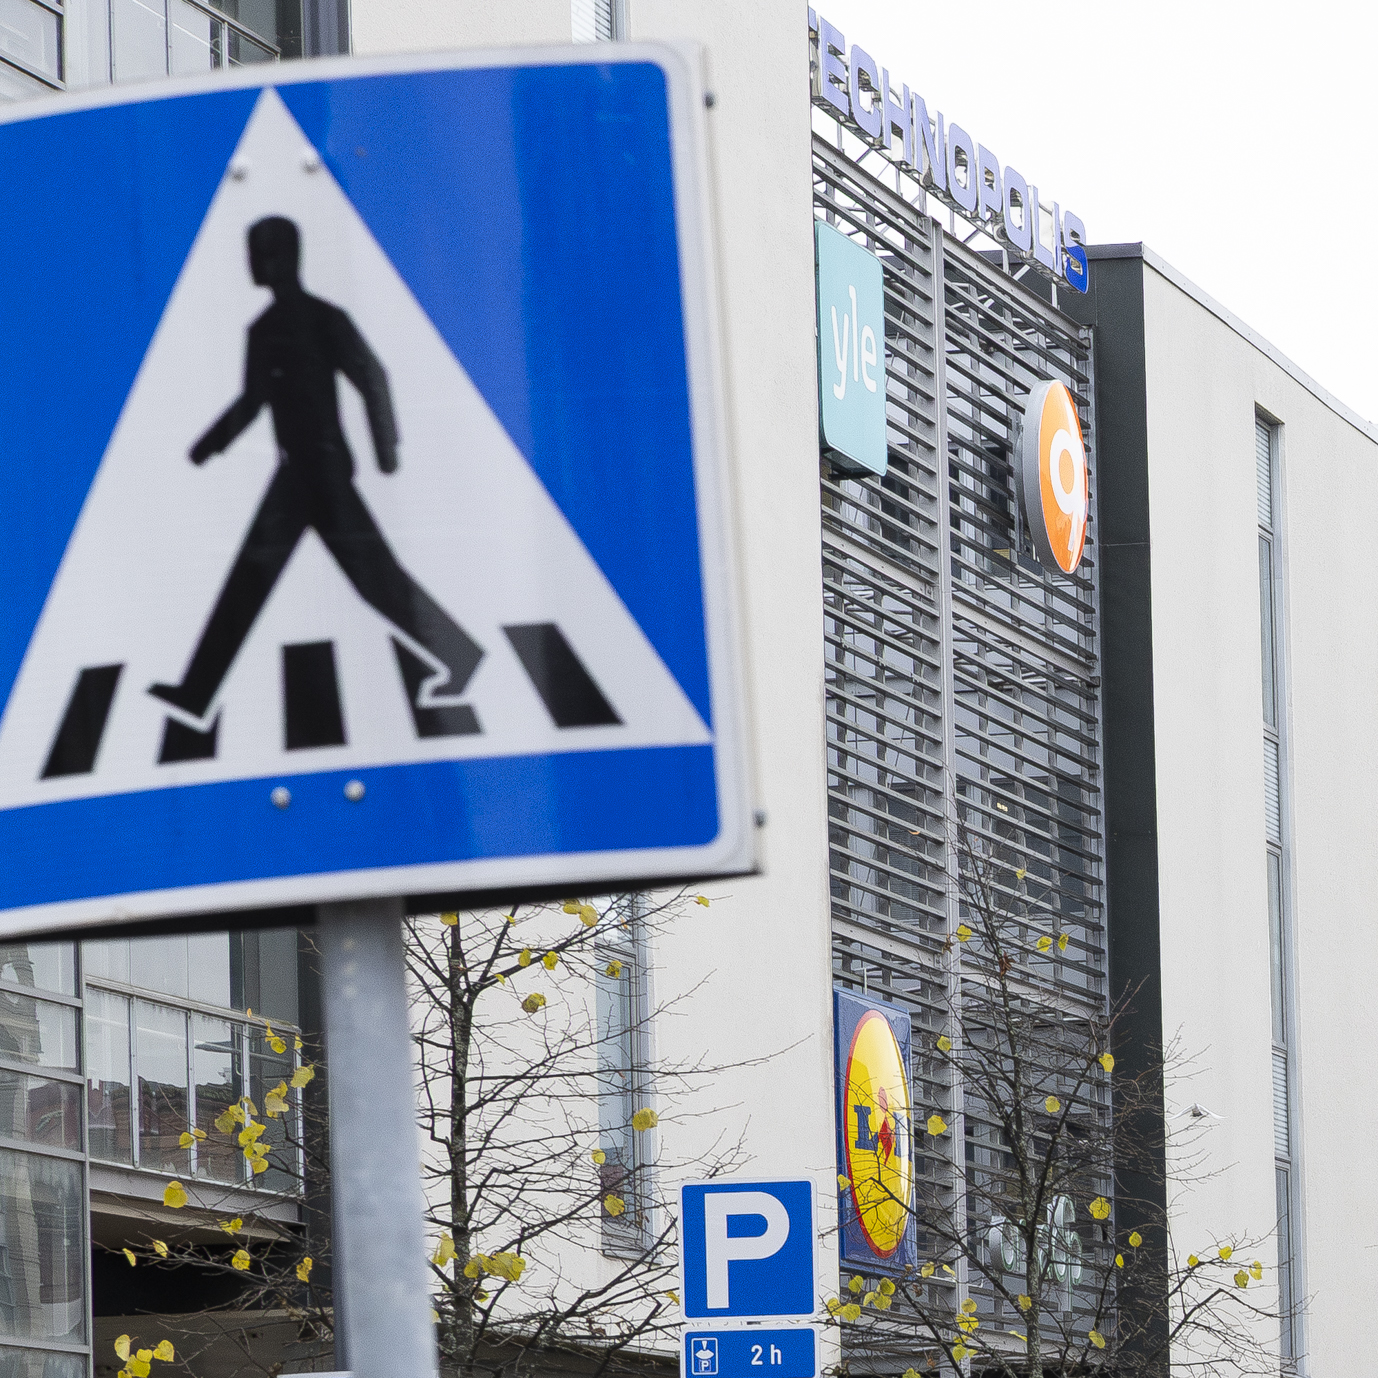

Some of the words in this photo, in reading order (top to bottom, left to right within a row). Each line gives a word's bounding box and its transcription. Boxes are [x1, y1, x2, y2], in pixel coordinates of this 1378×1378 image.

[831, 284, 877, 400] yle
[704, 1191, 790, 1309] P
[751, 1345, 763, 1365] 2
[770, 1344, 782, 1365] h
